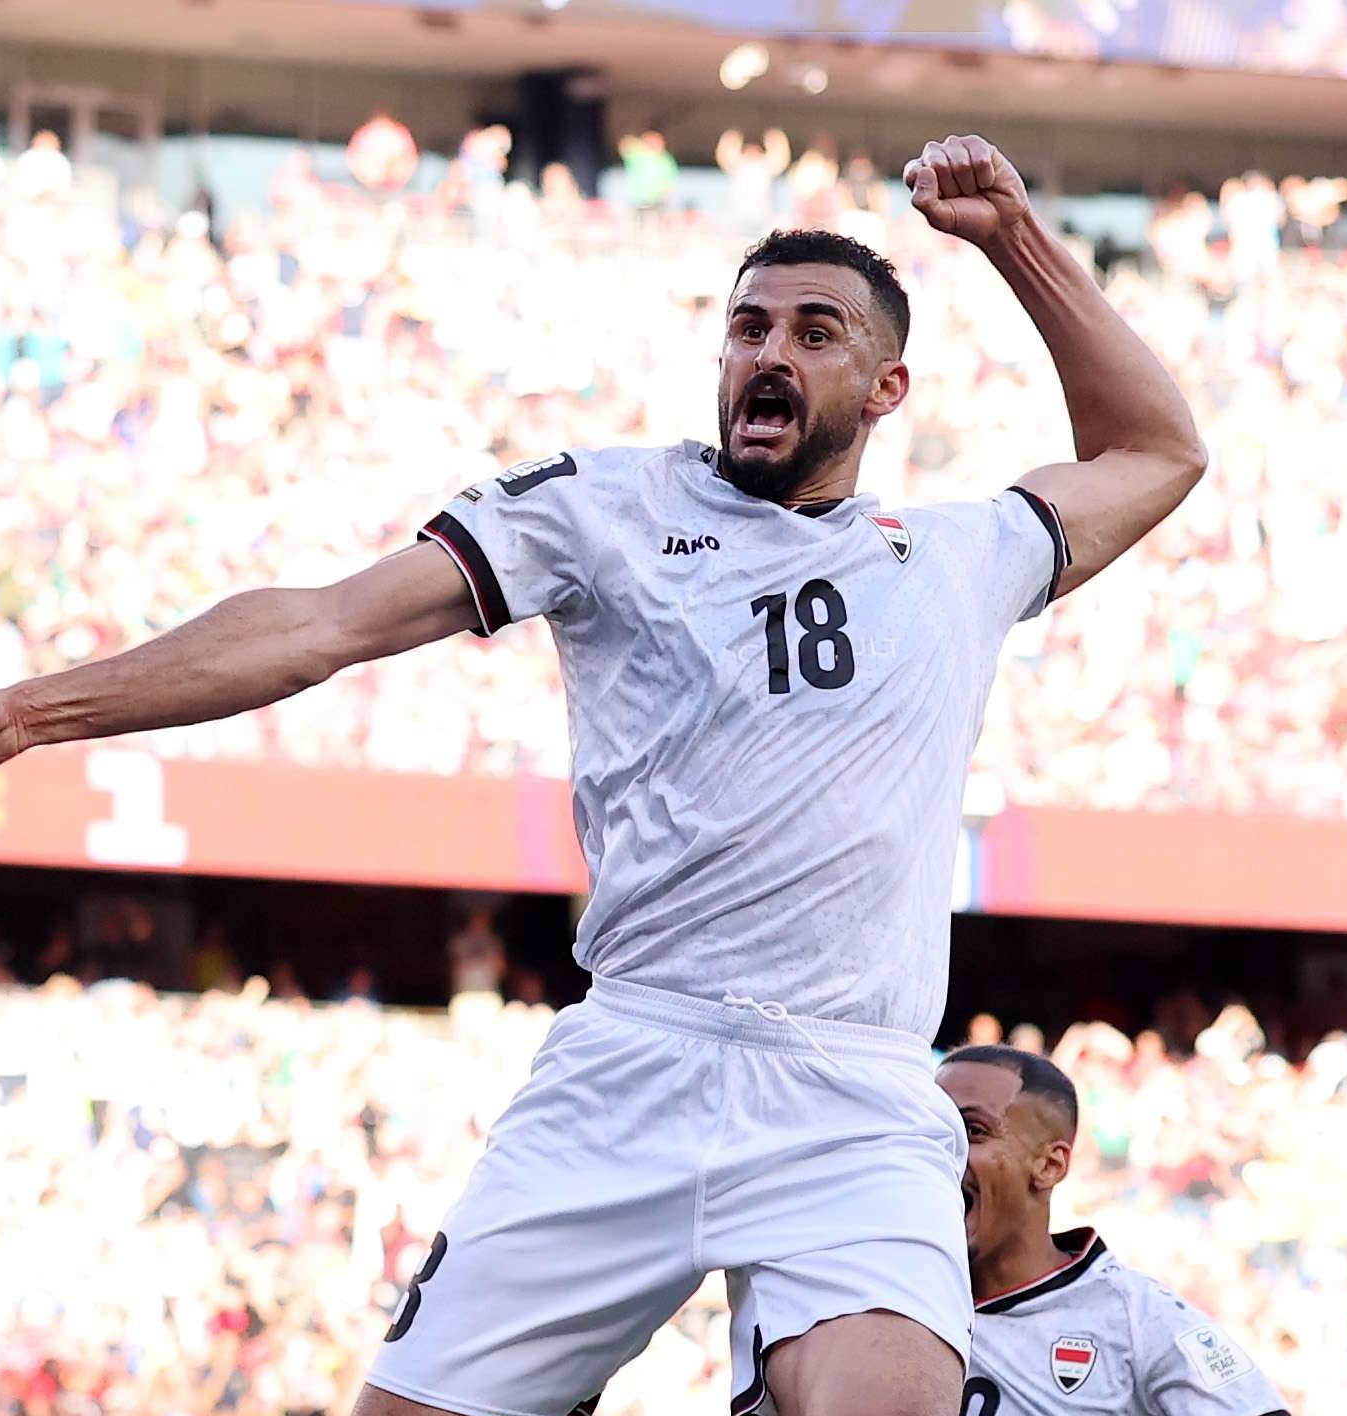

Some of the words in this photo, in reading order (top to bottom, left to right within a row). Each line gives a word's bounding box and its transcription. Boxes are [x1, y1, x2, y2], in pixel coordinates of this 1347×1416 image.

[662, 535, 720, 555] JAKO
[750, 578, 855, 694] 18
[84, 749, 189, 867] 1
